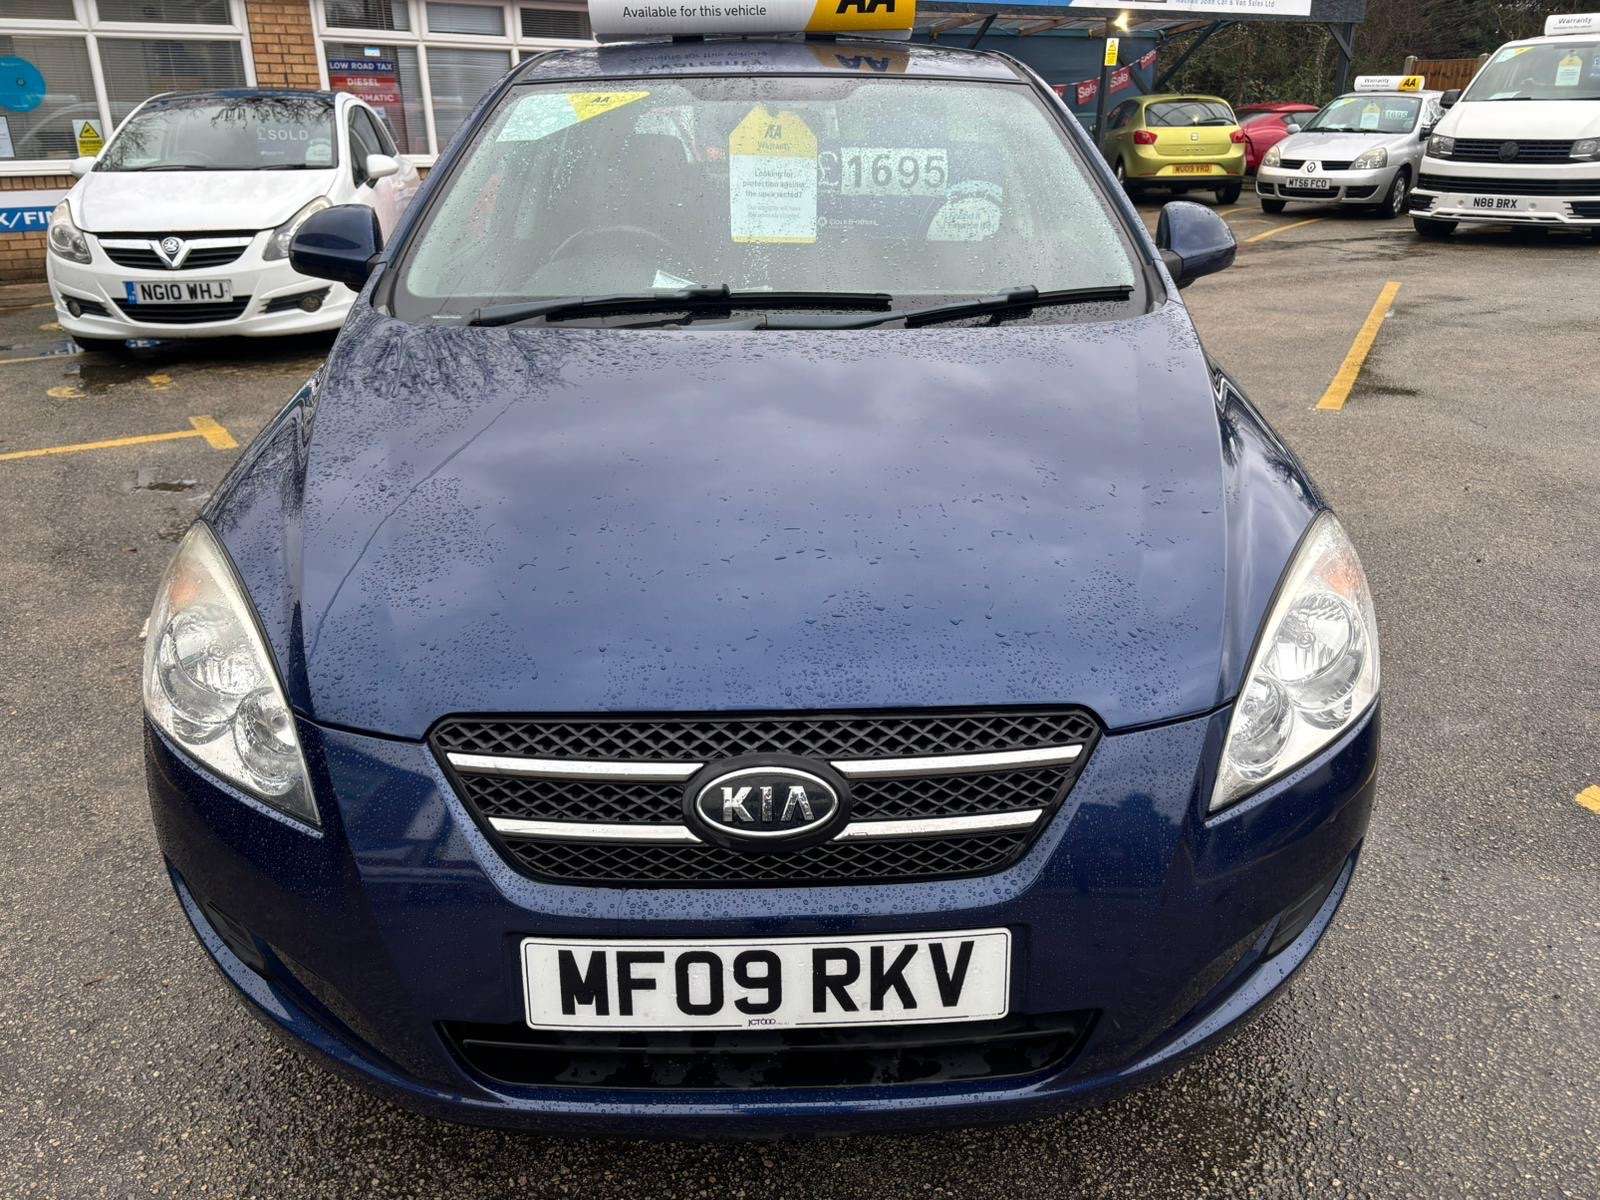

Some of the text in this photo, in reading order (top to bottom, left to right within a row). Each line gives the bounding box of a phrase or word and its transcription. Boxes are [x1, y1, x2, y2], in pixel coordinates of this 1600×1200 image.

[623, 5, 767, 18] Available for this vehicle
[328, 62, 393, 71] LOW ROAD TAX
[346, 77, 381, 87] DIESEL
[1111, 72, 1129, 88] Sale
[1402, 77, 1417, 88] AA
[1078, 85, 1097, 99] Sale
[268, 129, 309, 141] SOLD
[1473, 197, 1518, 209] N88 BRX
[140, 284, 182, 301] NG10
[186, 282, 225, 300] WHJ
[720, 785, 816, 822] KIA
[558, 940, 975, 1016] MF09 RKV
